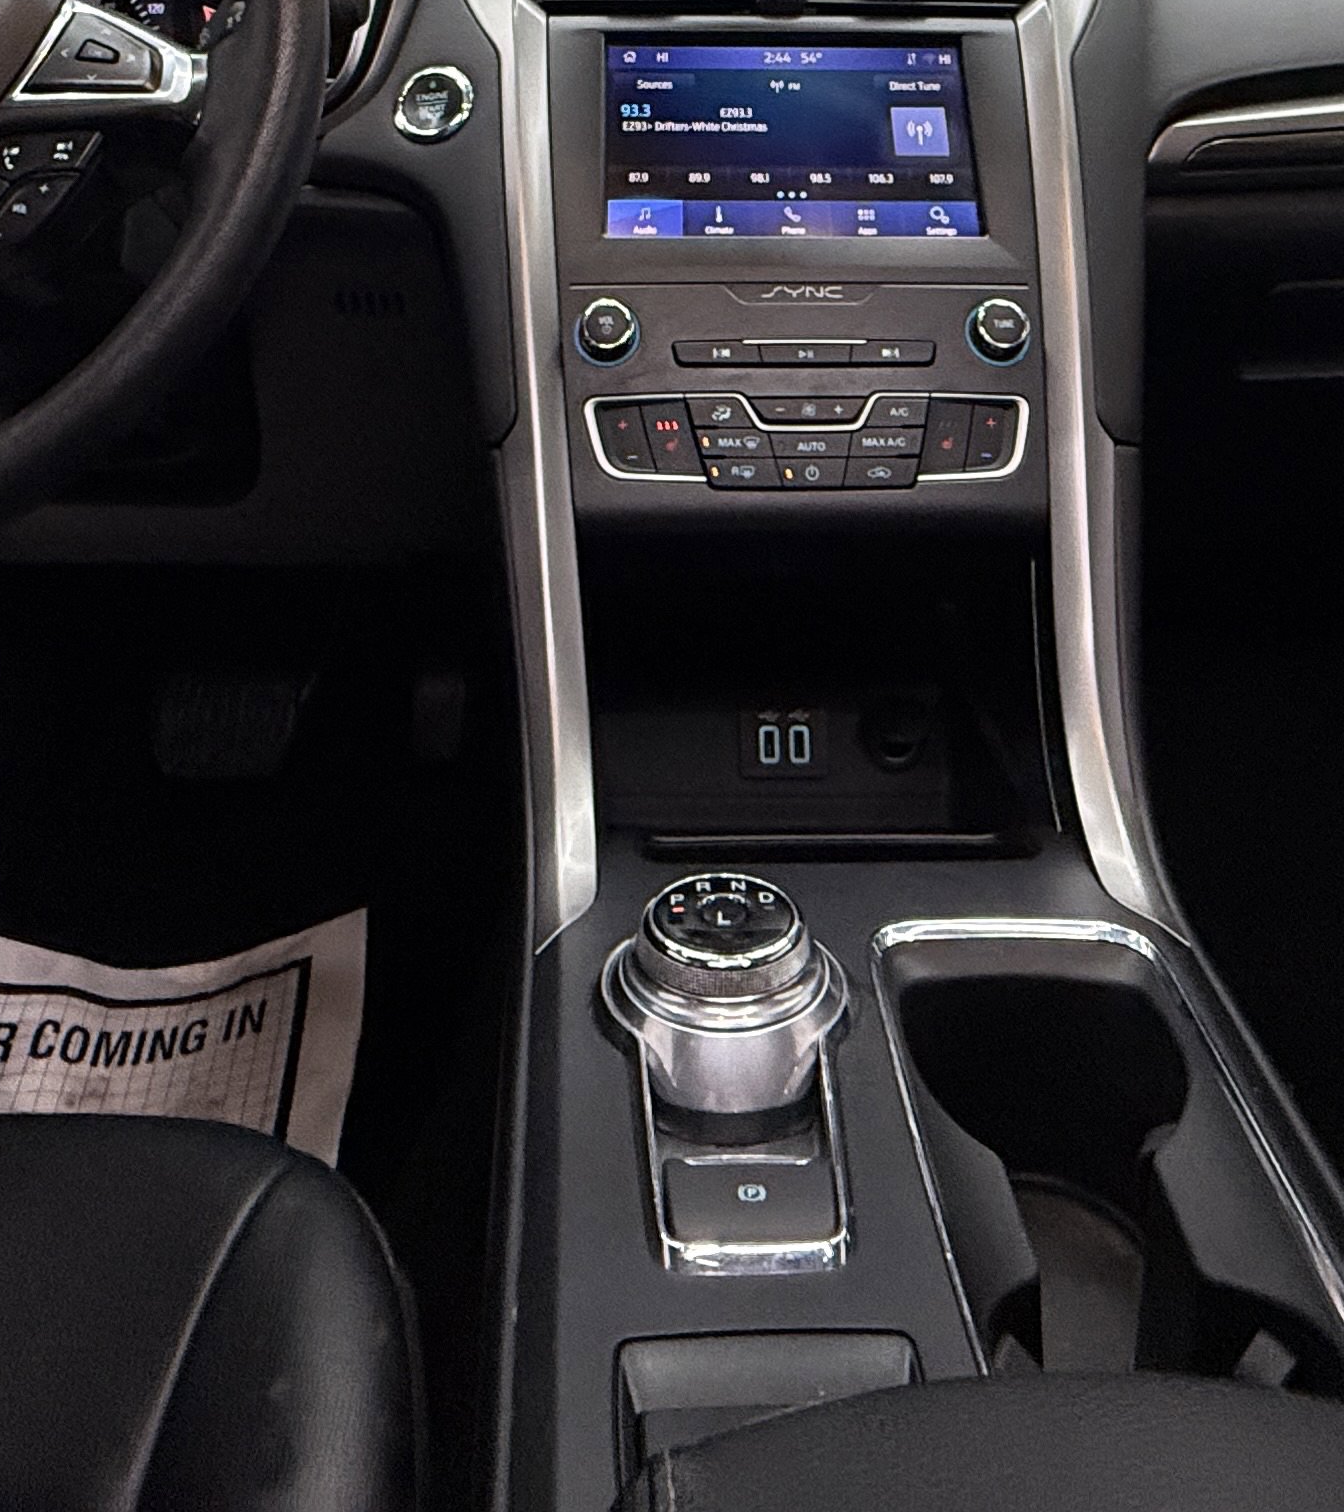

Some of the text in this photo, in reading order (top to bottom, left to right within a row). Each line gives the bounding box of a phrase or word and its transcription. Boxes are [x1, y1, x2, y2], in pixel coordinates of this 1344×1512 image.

[147, 3, 165, 15] 120
[656, 52, 669, 64] HI
[763, 51, 823, 64] 2:44 54°
[938, 53, 952, 65] HI
[636, 79, 674, 90] Sources
[888, 81, 942, 92] Direct Tune
[415, 90, 449, 102] ENGINE
[620, 104, 652, 118] 93.3
[719, 107, 754, 119] EZ93.3
[721, 121, 769, 133] Christmas
[628, 172, 650, 184] 87.9
[632, 224, 658, 236] Audio
[925, 225, 959, 237] Settings
[760, 285, 844, 299] SYNC
[598, 315, 614, 326] VOL
[993, 319, 1015, 329] TUNE
[889, 406, 909, 417] A/C
[717, 438, 743, 448] MAX
[796, 442, 827, 452] AUTO
[861, 438, 906, 448] MAX A/C
[670, 880, 775, 906] P R N D
[717, 910, 732, 926] L
[27, 1018, 209, 1069] COMING
[220, 998, 269, 1042] IN
